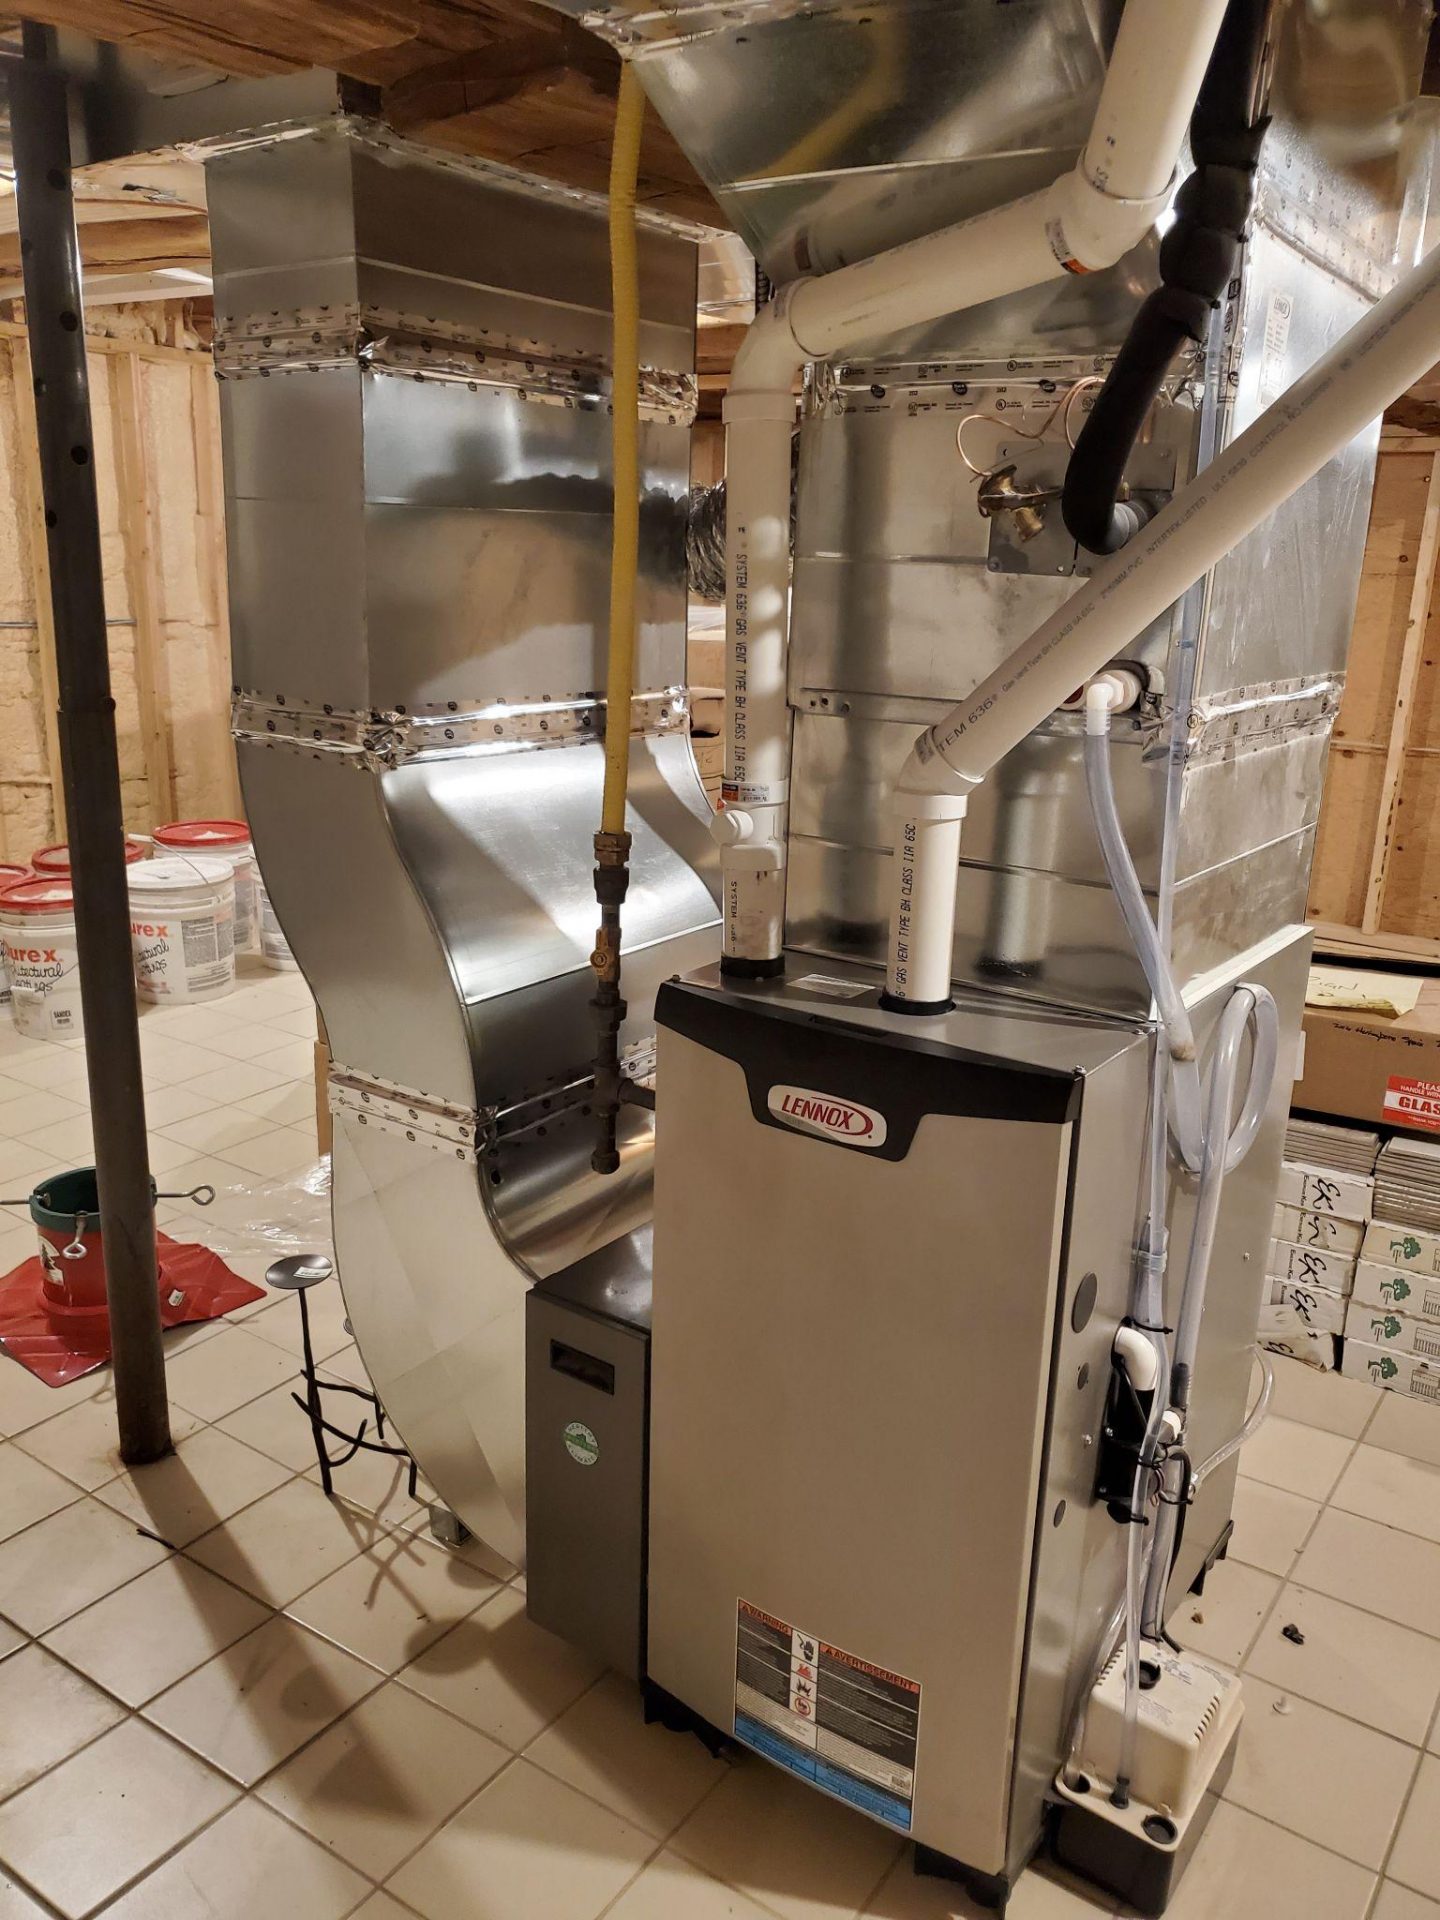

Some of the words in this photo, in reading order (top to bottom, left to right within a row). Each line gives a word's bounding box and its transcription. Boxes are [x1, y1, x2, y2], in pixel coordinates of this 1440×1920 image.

[736, 553, 748, 589] SYSTEM
[735, 618, 747, 636] GAS
[735, 641, 747, 663] VENT
[735, 669, 747, 692] TYPE
[735, 696, 746, 708] BH
[968, 699, 994, 724] 636
[734, 712, 746, 741] CLASS
[905, 823, 917, 842] 65C
[901, 867, 914, 896] CLASS
[730, 880, 738, 919] SYSTEM
[900, 899, 911, 912] BH
[131, 922, 169, 938] urex
[898, 916, 911, 937] TYPE
[897, 942, 909, 963] VENT
[896, 967, 908, 984] GAS
[781, 1094, 855, 1130] LENNOX
[748, 1605, 791, 1635] WARNING
[833, 1650, 914, 1690] AVERTISSEMENT
